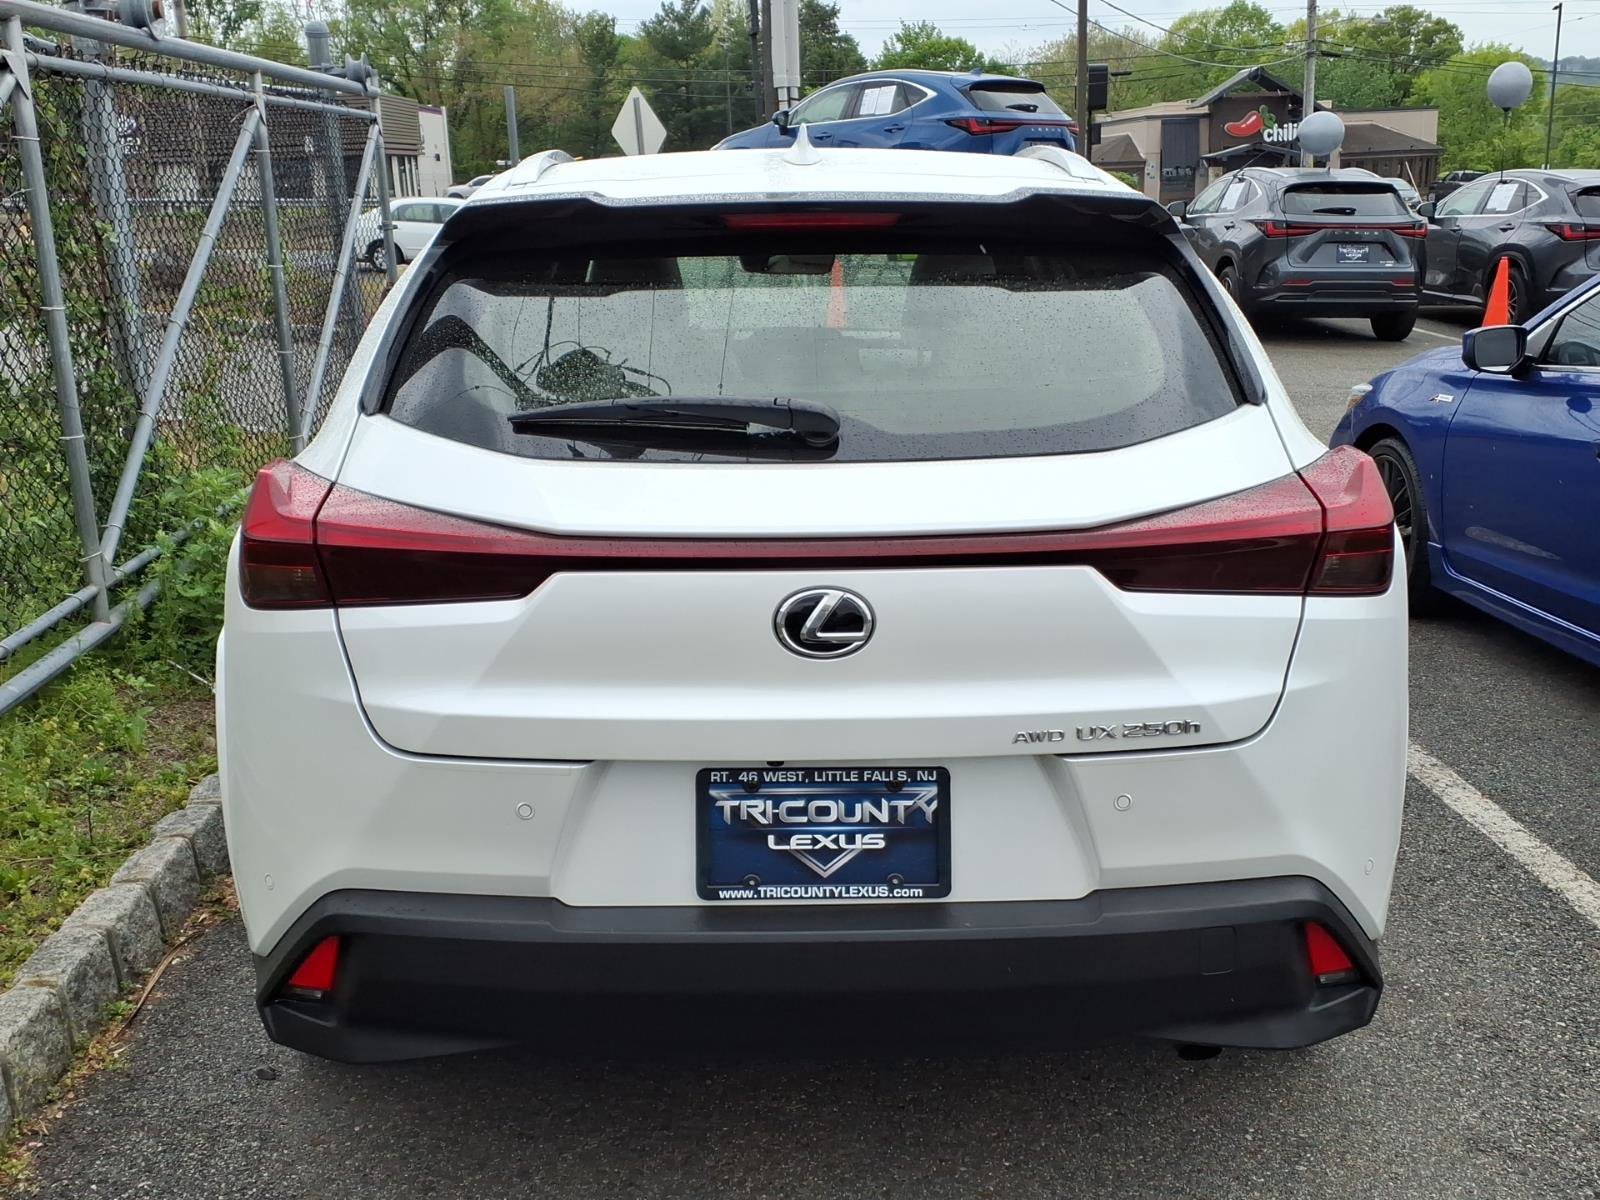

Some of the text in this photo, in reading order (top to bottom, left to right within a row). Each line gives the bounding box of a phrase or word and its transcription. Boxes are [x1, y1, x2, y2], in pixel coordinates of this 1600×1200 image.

[1263, 122, 1299, 142] chili
[1012, 719, 1201, 744] AWD UX 250h
[710, 769, 937, 783] RT. 46 WEST, LITTLE FALLS, NJ
[714, 797, 938, 825] TRI-COUNTY
[767, 833, 886, 850] LEXUS
[718, 886, 924, 899] www.TRICOUNTYLEXUS.com
